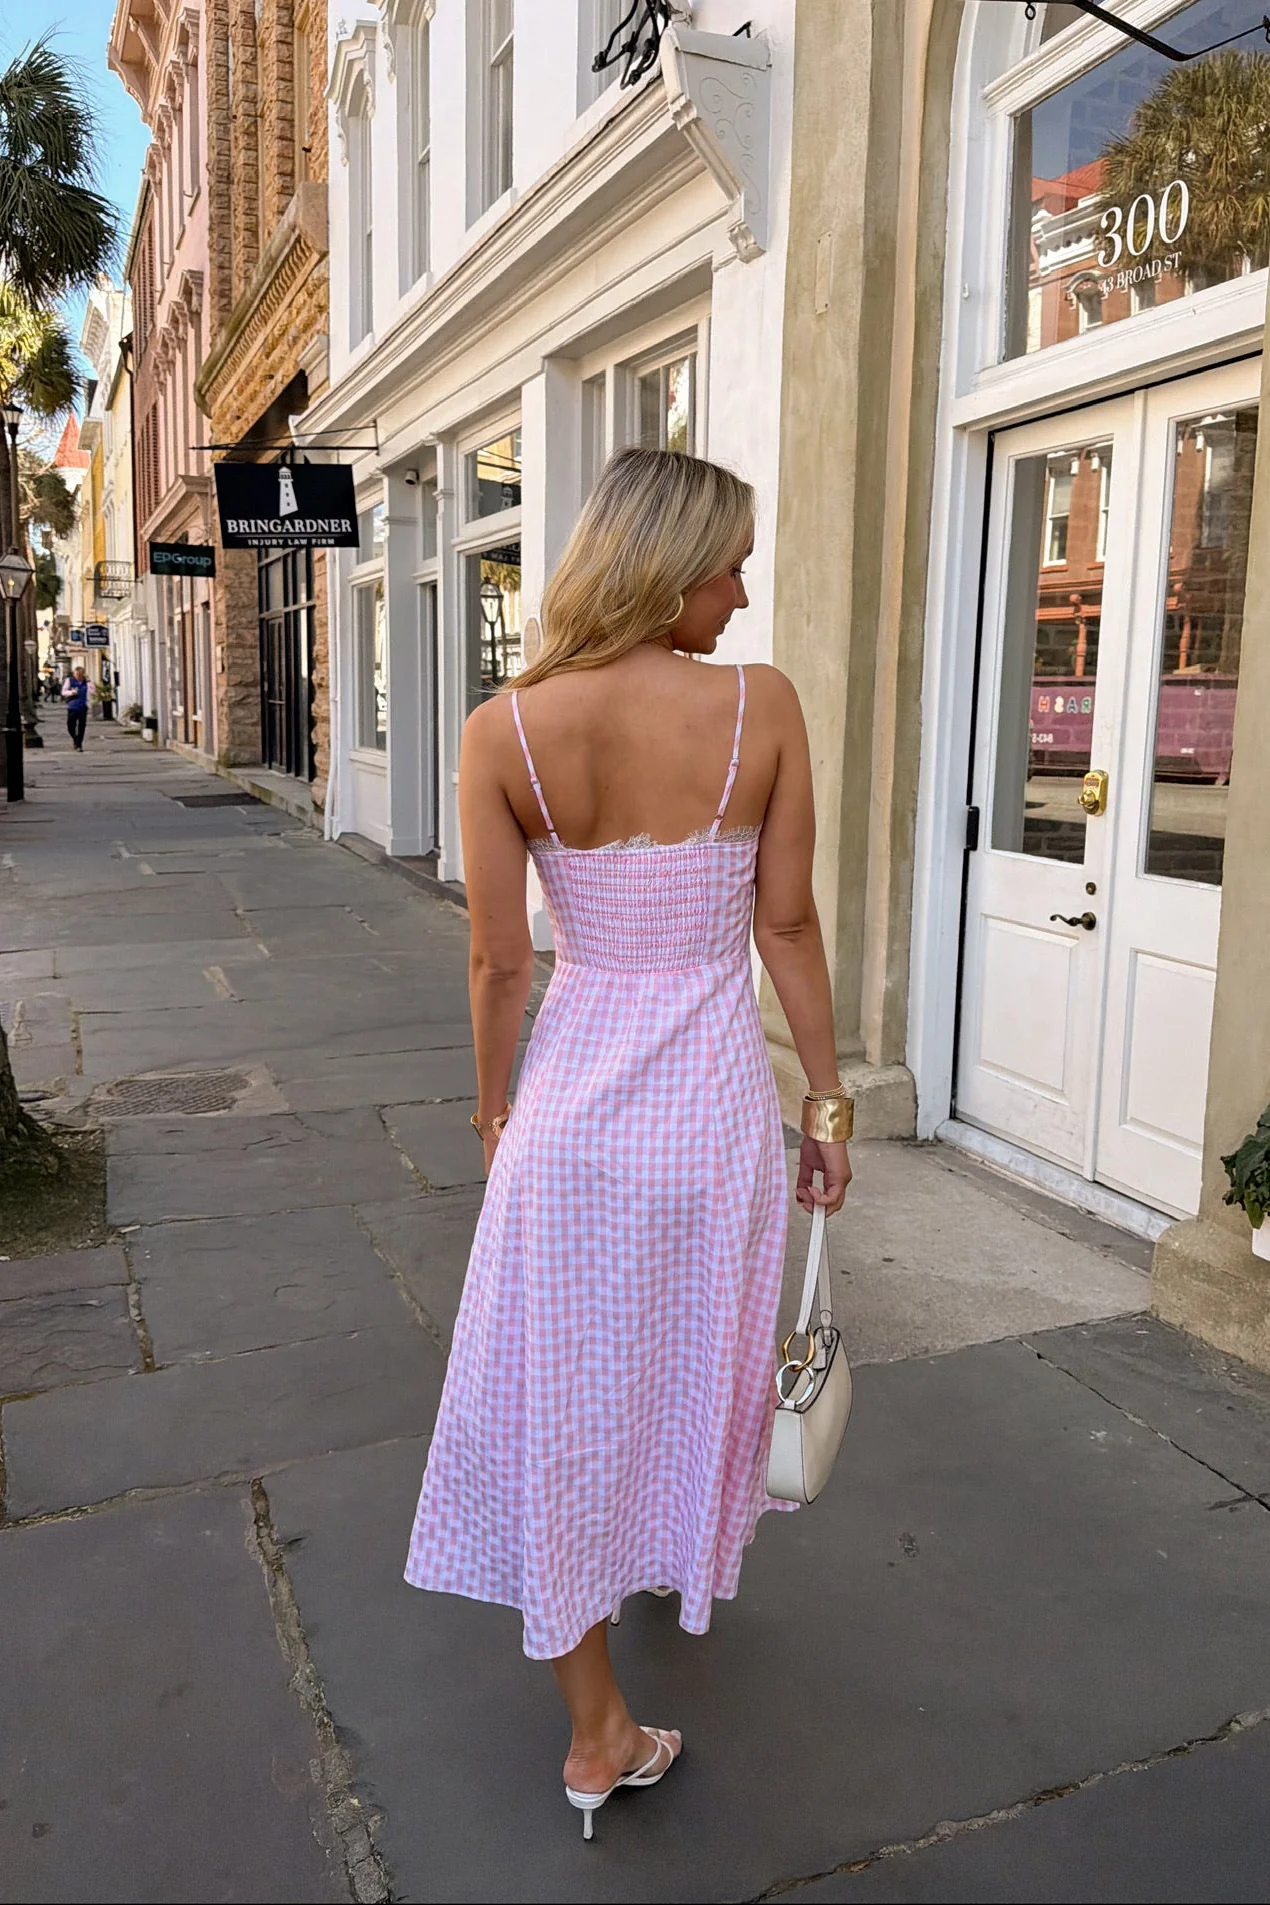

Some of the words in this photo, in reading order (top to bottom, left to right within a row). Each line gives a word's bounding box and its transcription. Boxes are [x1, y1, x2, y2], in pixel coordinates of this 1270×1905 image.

[1097, 179, 1190, 267] 300
[1116, 259, 1162, 289] BROAD
[1163, 251, 1182, 272] ST
[226, 519, 352, 533] BRINGARDNER
[247, 538, 284, 546] INJURY
[287, 538, 308, 546] LAW
[312, 538, 335, 546] FIRM
[153, 551, 212, 568] EPGroup
